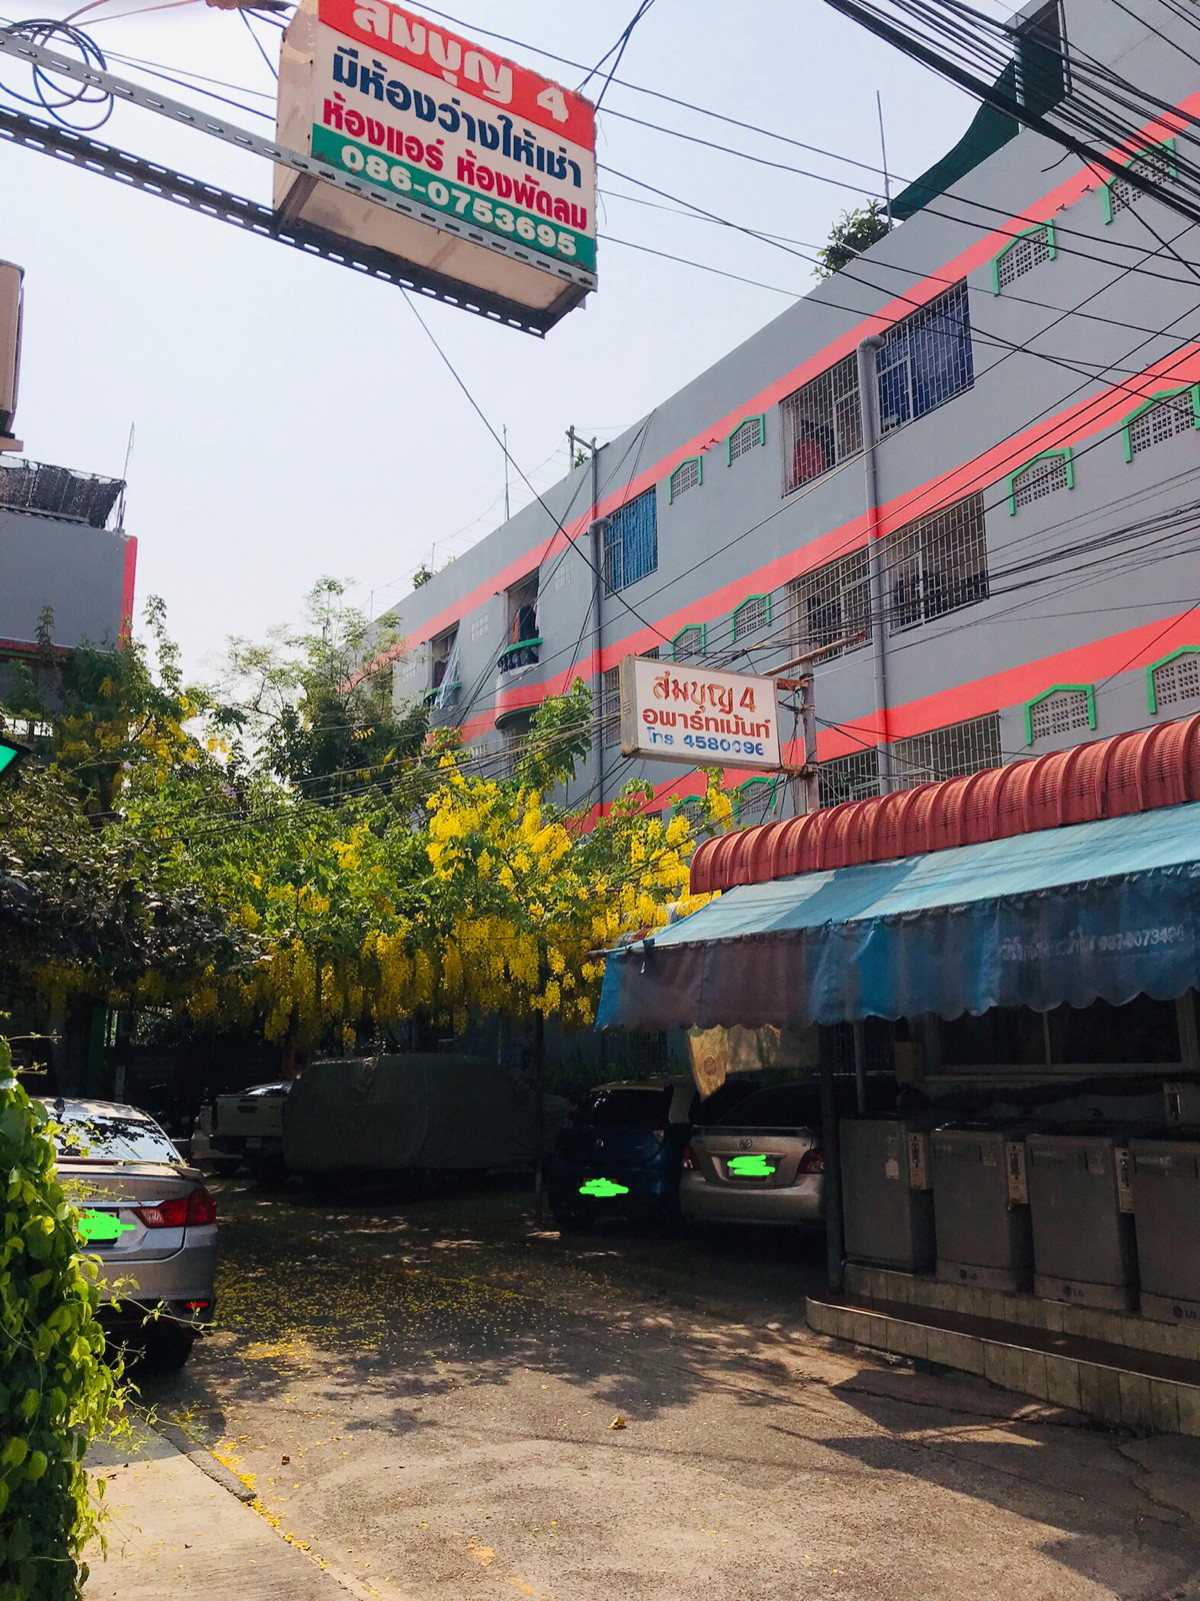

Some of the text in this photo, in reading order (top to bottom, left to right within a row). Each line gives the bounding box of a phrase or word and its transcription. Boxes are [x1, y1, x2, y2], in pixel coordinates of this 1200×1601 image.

[332, 45, 582, 189] มีห้องว่างให้เช่า
[352, 0, 569, 123] สมบุญ 4
[323, 91, 587, 231] ห้องแอร์ ห้องพัดลม
[341, 145, 577, 256] 086-0753695
[739, 686, 756, 713] 4
